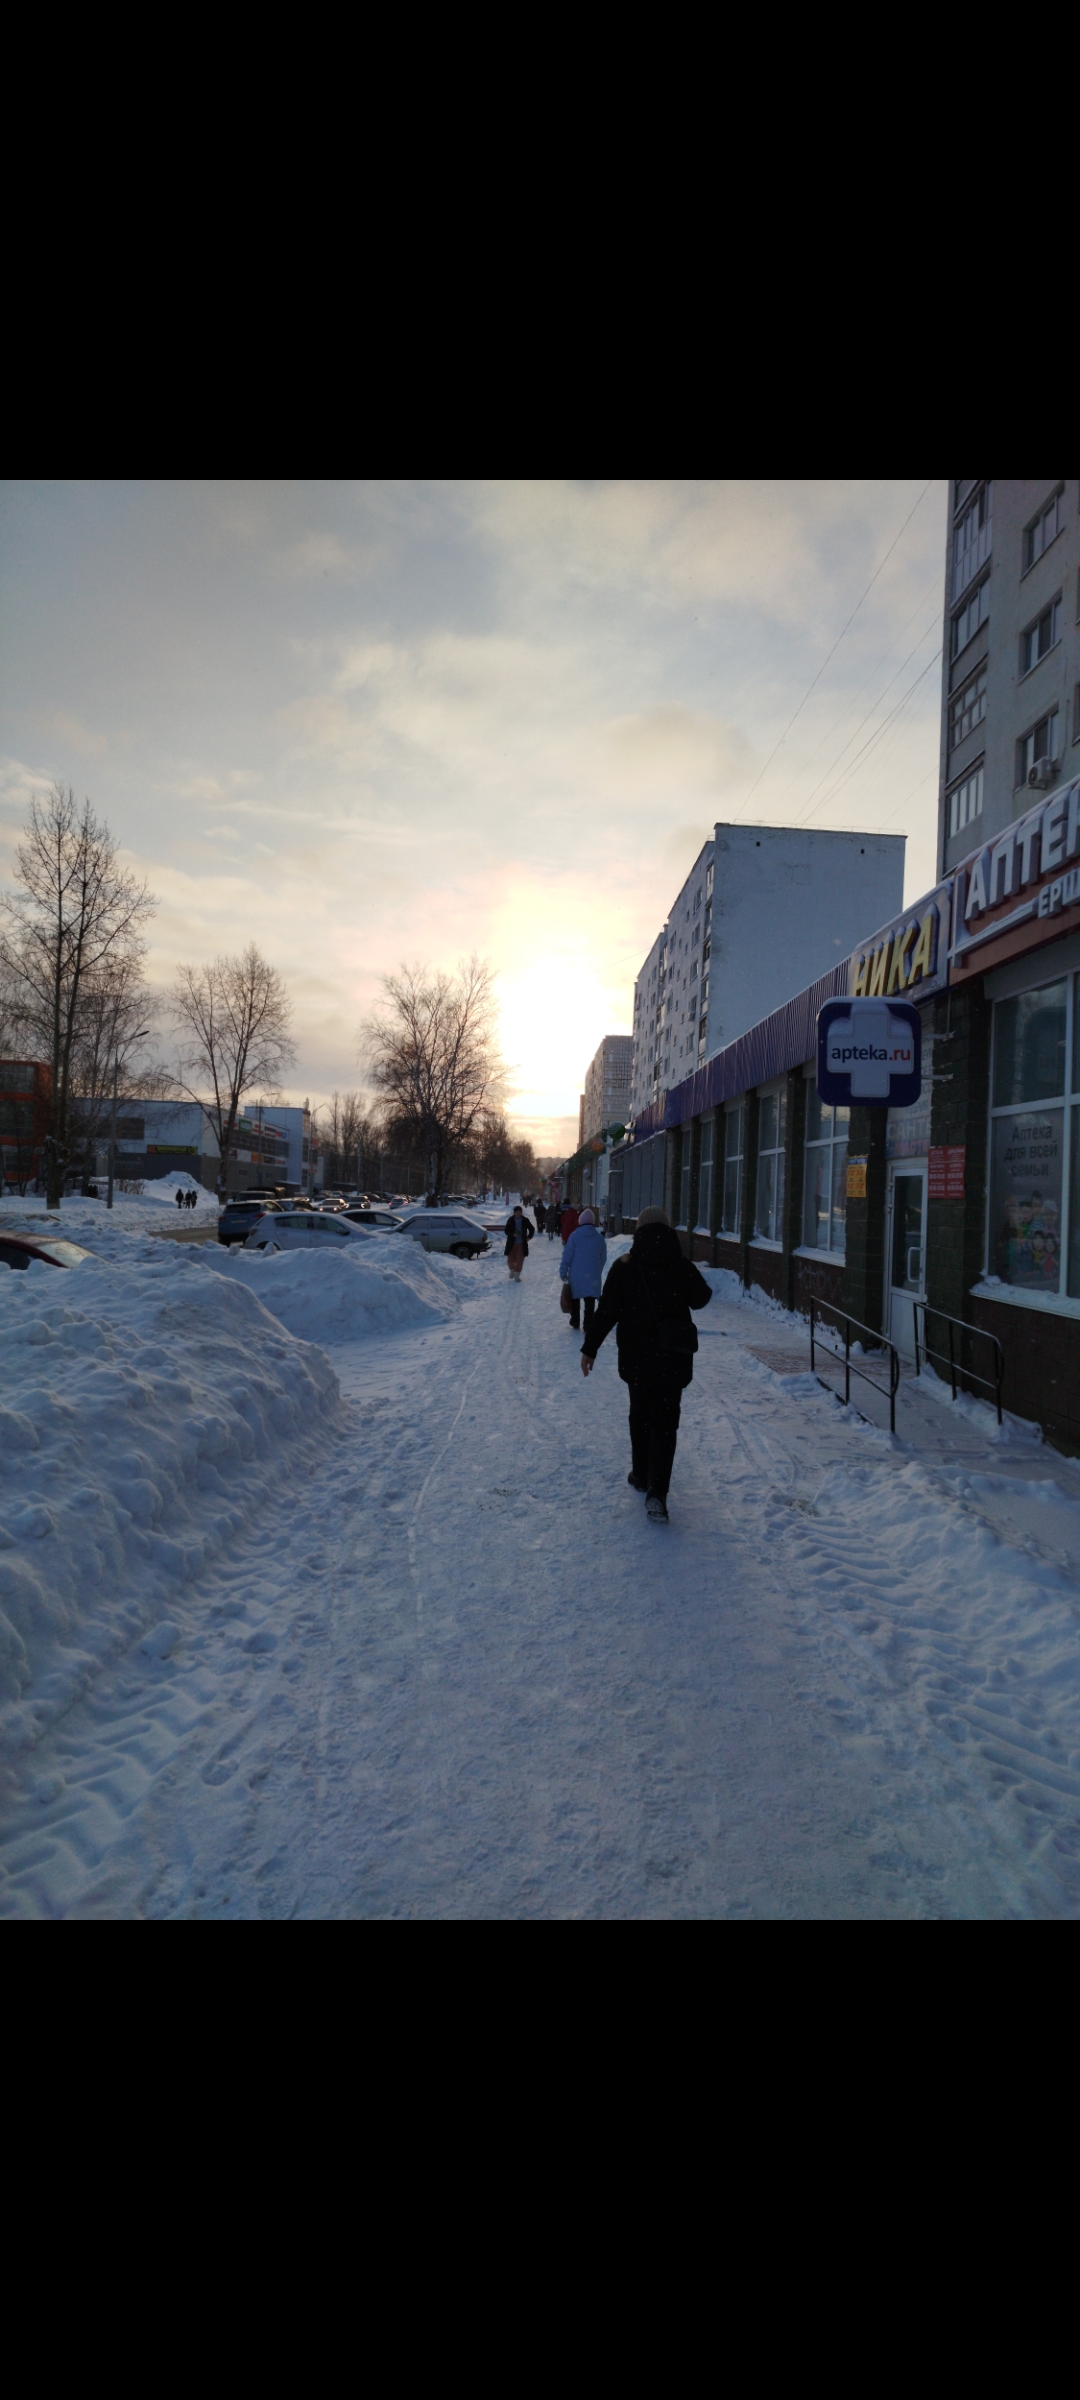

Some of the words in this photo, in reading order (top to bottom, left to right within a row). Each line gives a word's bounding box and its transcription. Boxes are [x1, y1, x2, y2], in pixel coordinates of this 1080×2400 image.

[854, 912, 934, 997] НИКА
[831, 1044, 911, 1063] apteka.ru
[1012, 1125, 1053, 1142] Аптека
[1004, 1146, 1027, 1162] для
[1030, 1139, 1058, 1158] всей
[1011, 1163, 1049, 1177] семьи
